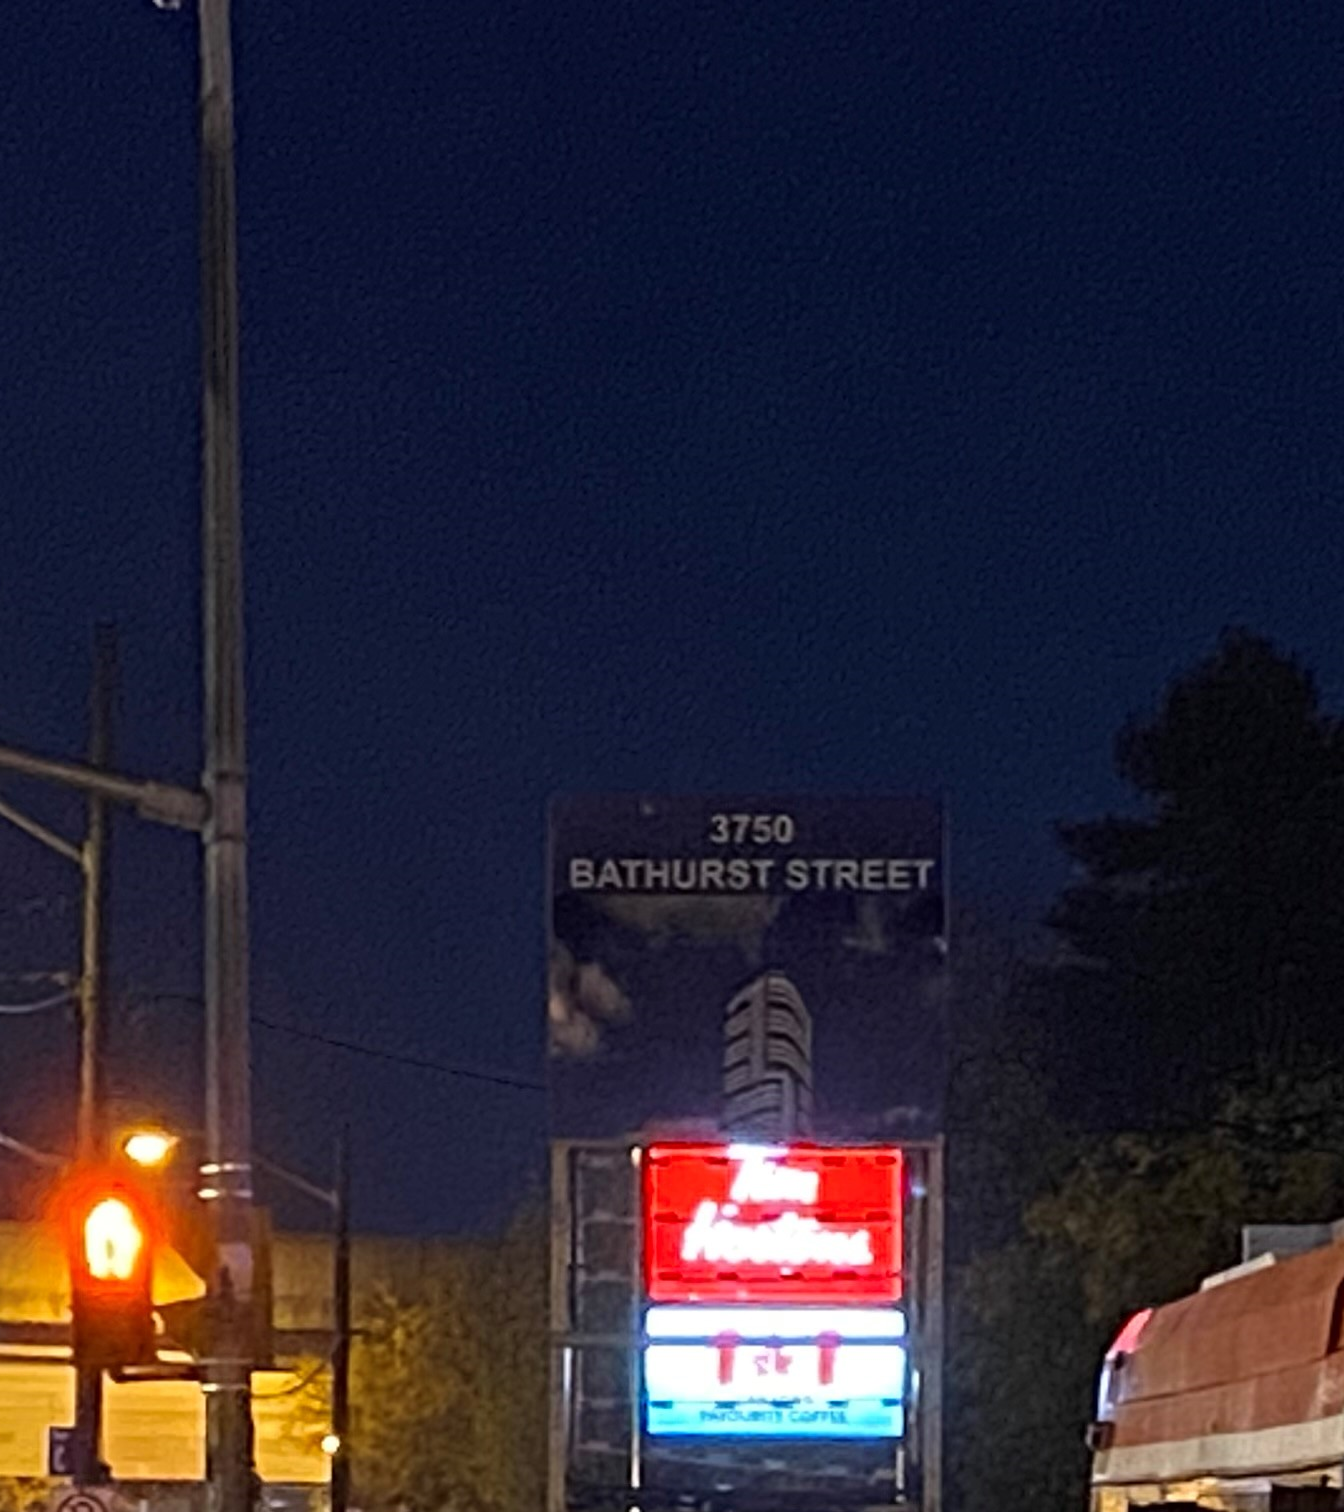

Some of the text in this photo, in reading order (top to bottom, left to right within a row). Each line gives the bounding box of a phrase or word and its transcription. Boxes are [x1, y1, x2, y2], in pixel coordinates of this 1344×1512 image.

[709, 814, 794, 844] 3750
[568, 857, 935, 890] BATHURST STREET
